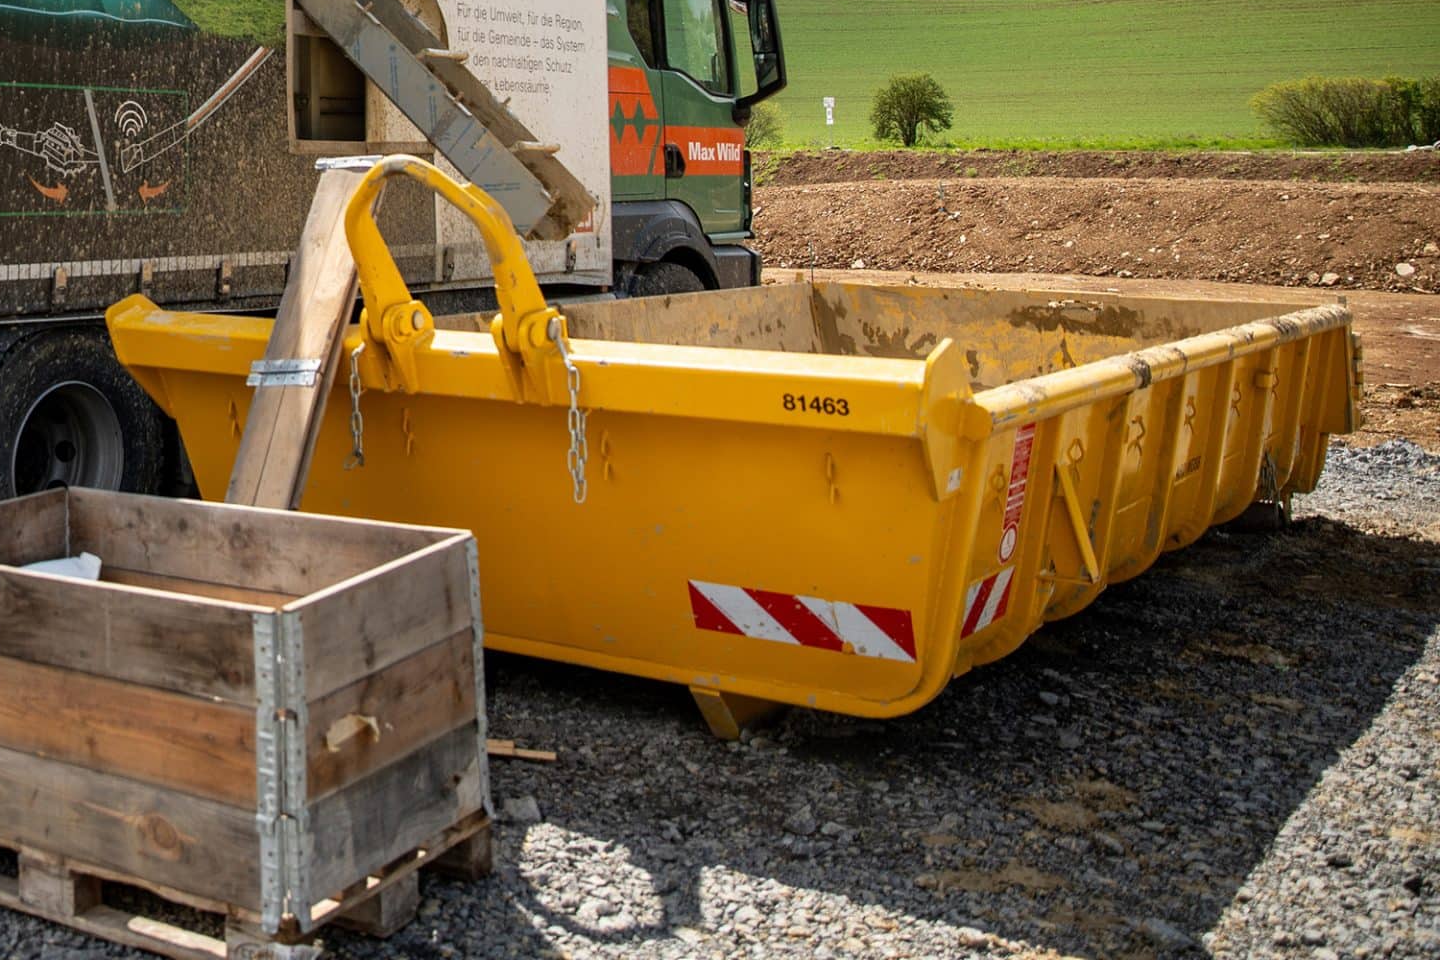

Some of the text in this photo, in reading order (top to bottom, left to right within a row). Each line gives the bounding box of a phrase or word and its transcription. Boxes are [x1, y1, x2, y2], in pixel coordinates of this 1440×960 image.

[457, 2, 471, 19] Für
[474, 6, 487, 20] die
[490, 7, 525, 25] Umwelt,
[527, 10, 540, 25] für
[541, 12, 553, 27] die
[457, 26, 471, 41] für
[472, 28, 486, 43] die
[488, 29, 531, 47] Gemeinde
[540, 36, 555, 50] das
[556, 36, 585, 54] System
[472, 53, 572, 74] den nachhaltigen Schutz
[688, 141, 741, 161] Max Wild
[783, 393, 850, 417] 81463
